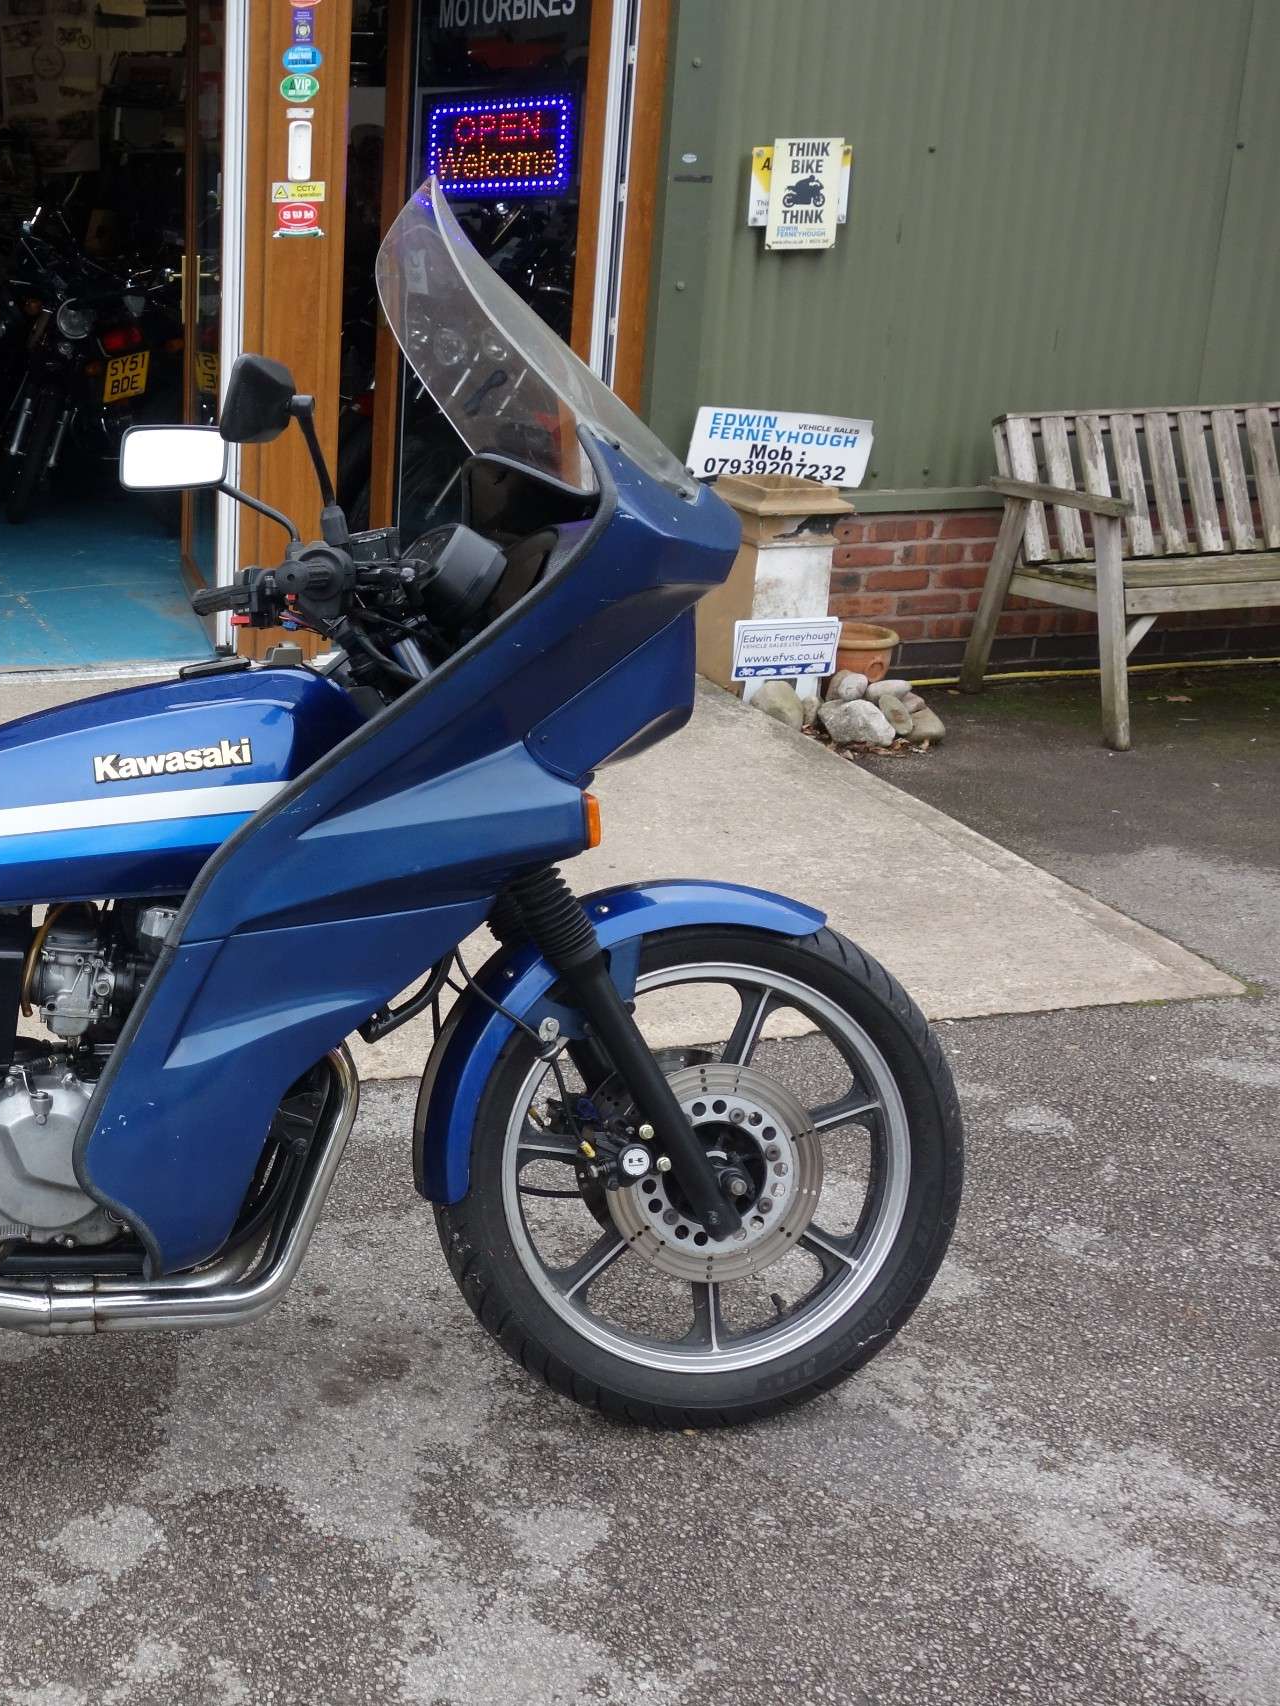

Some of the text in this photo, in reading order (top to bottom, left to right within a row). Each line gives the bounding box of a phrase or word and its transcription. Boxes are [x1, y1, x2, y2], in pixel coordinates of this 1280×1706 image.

[454, 110, 543, 144] OPEN
[788, 142, 830, 157] THINK
[436, 144, 558, 181] Welcome
[791, 159, 824, 174] BIKE
[782, 209, 824, 224] THINK
[110, 353, 145, 377] SY51
[111, 373, 141, 395] BDE
[712, 412, 778, 429] EDWIN
[798, 423, 860, 435] VEHICLE SALES
[708, 426, 858, 449] FERNEYHOUGH
[749, 443, 793, 462] Mob
[704, 457, 846, 482] 07939207232
[743, 631, 836, 644] Edwin Ferneyhough
[744, 651, 825, 664] www.efvs.co.uk
[93, 738, 253, 784] Kawasaki
